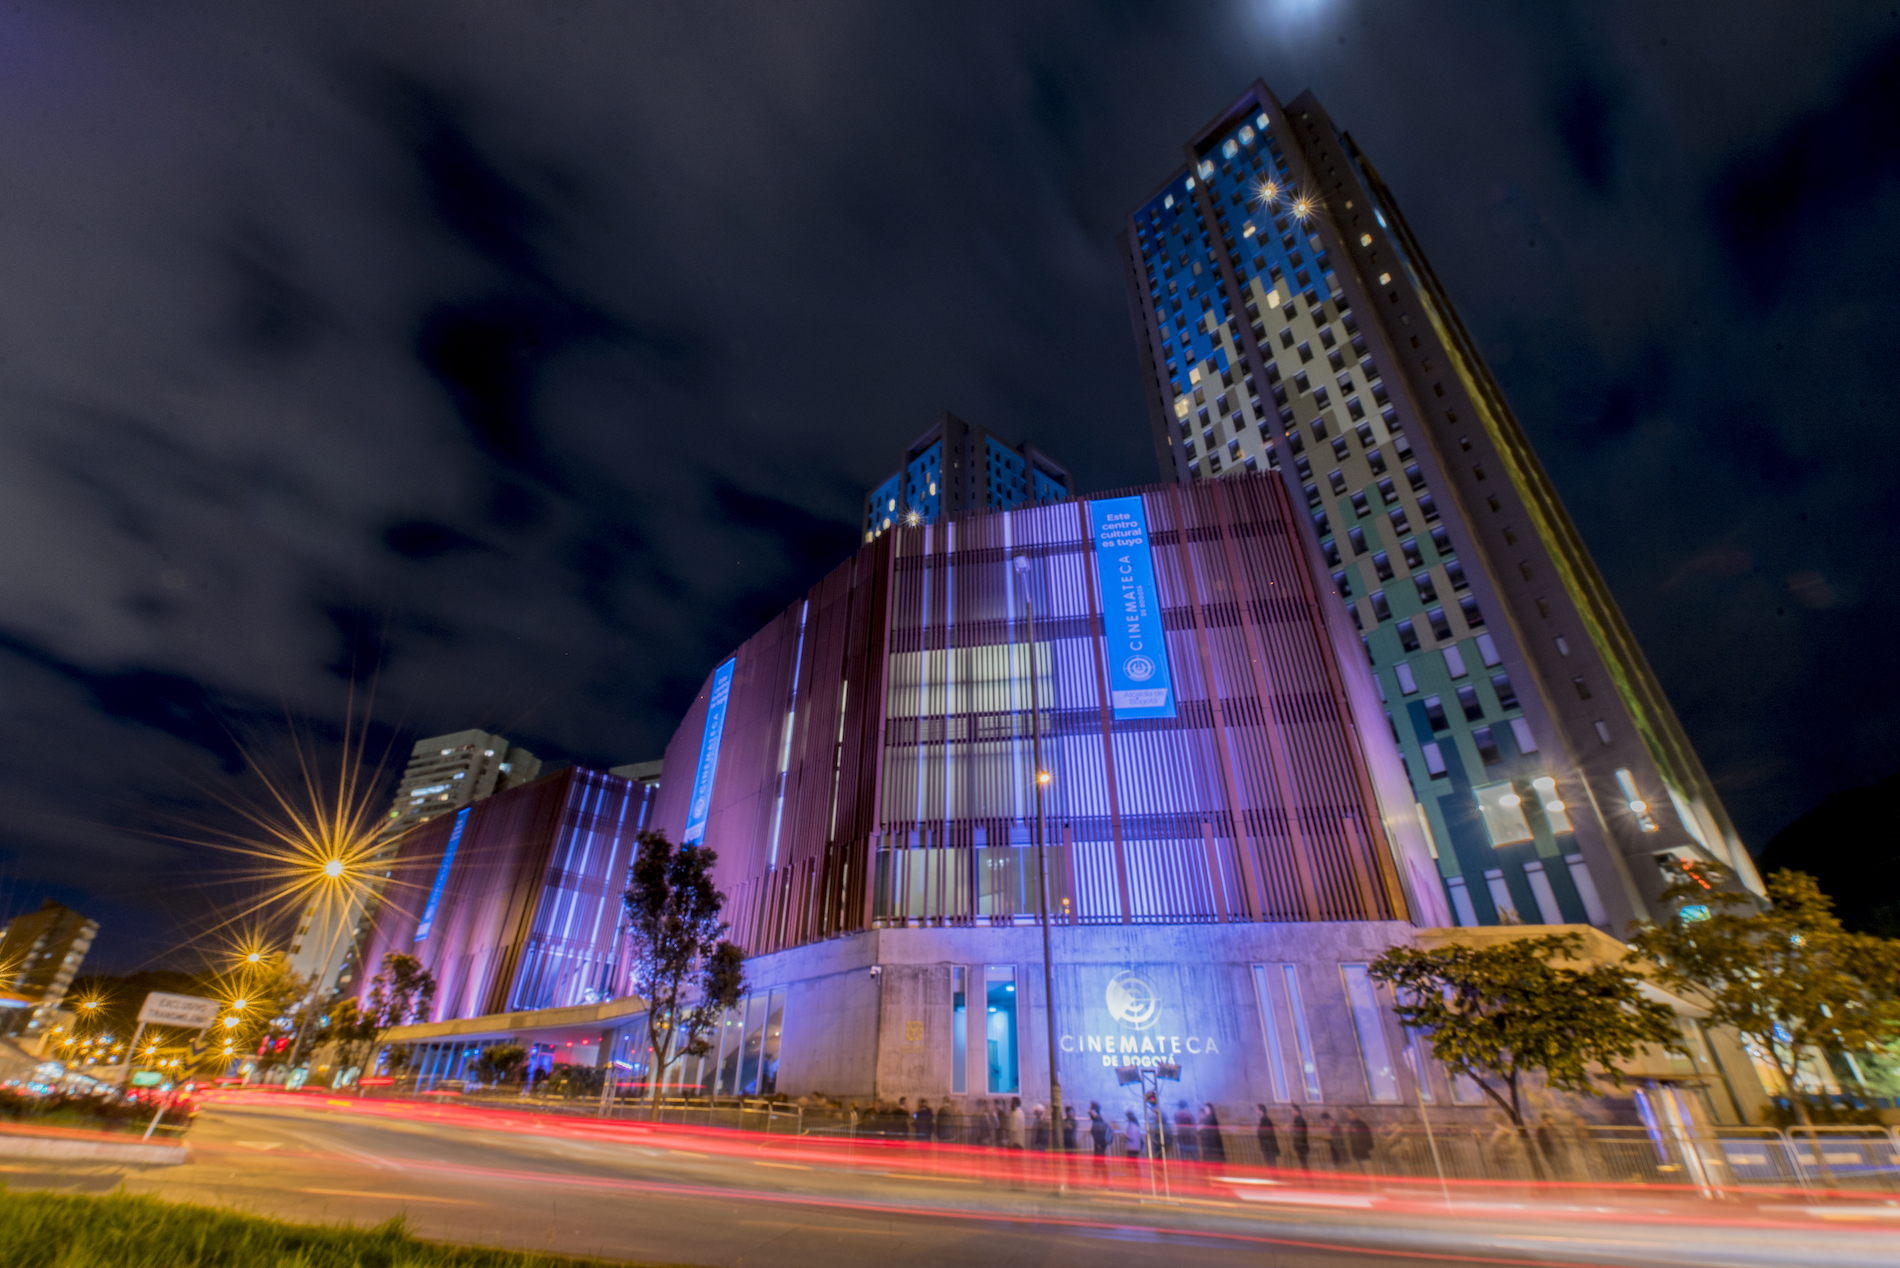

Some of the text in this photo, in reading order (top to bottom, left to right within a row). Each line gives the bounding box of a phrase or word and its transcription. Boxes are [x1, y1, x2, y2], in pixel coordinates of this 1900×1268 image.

[1106, 513, 1131, 521] Este
[1102, 521, 1138, 530] centro
[1100, 528, 1142, 539] cultural
[1102, 538, 1143, 548] es tuyo
[1119, 555, 1143, 651] CINEMATECA
[1060, 1035, 1219, 1054] CINEMATECA
[1102, 1055, 1119, 1067] DE
